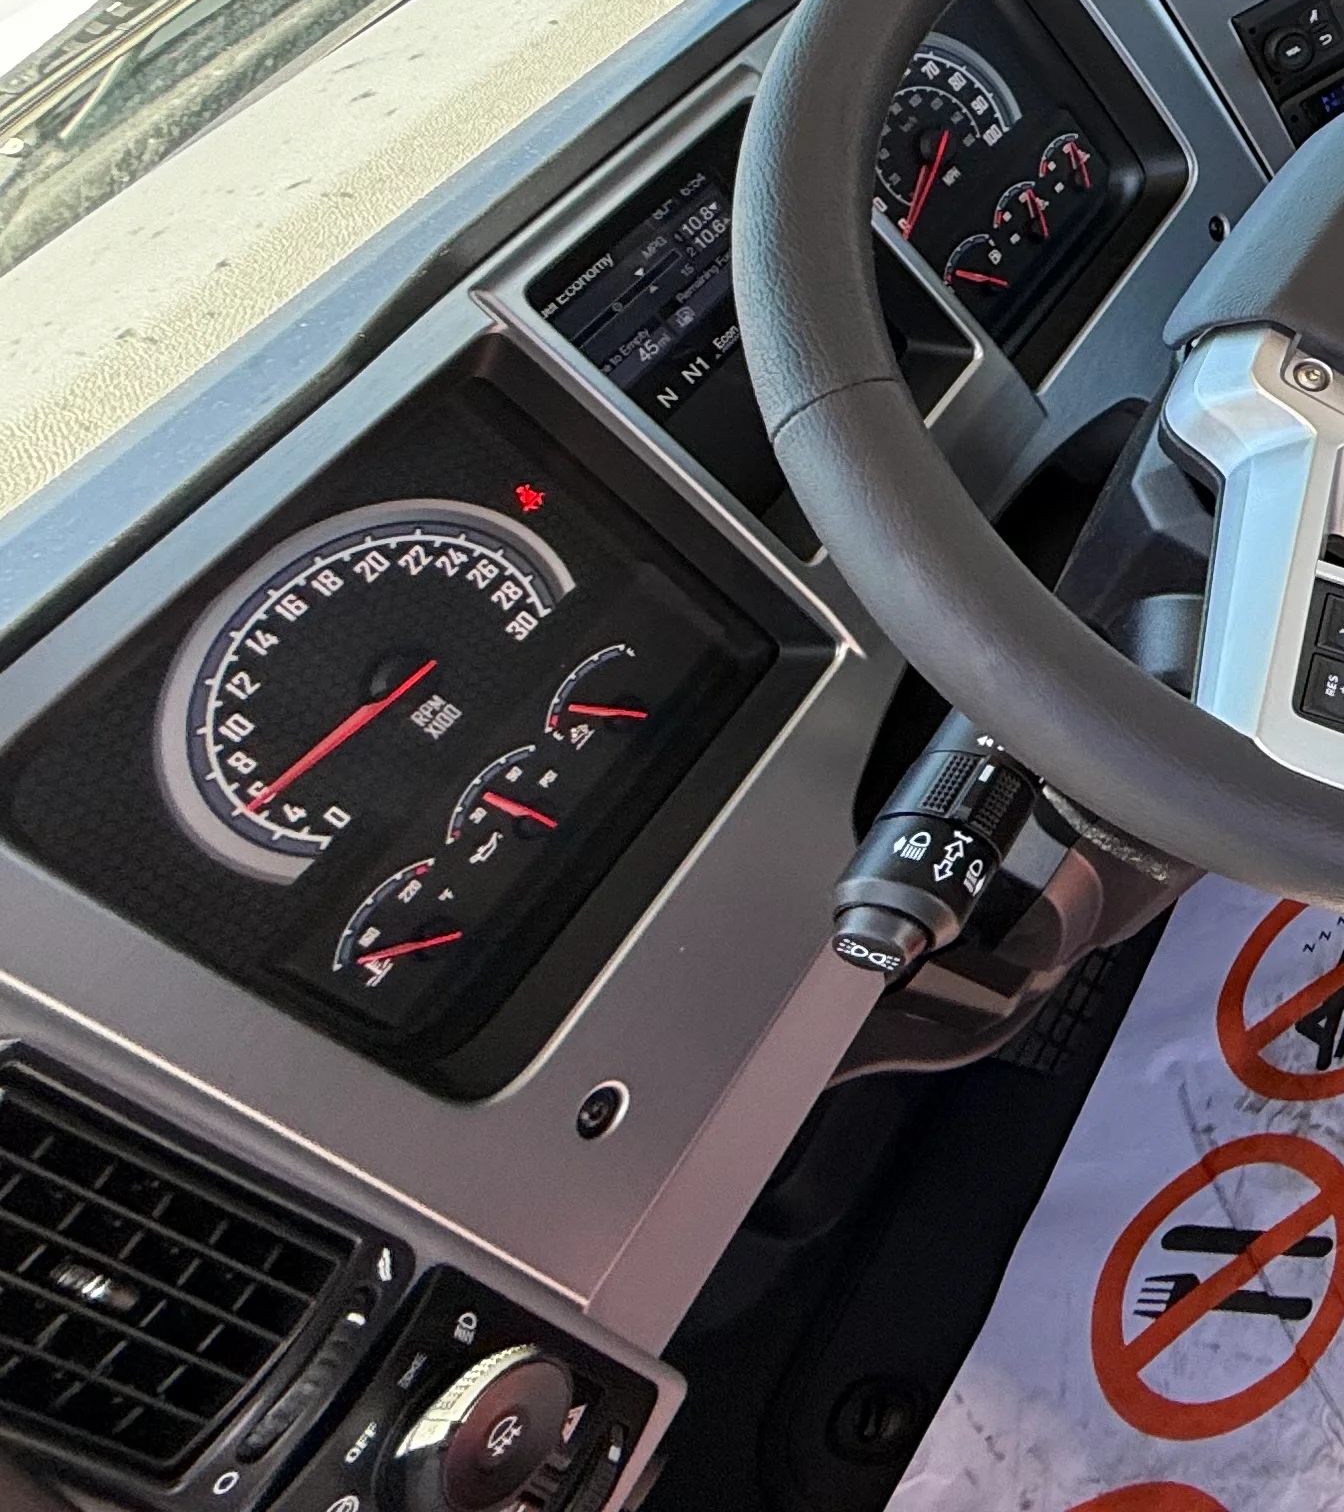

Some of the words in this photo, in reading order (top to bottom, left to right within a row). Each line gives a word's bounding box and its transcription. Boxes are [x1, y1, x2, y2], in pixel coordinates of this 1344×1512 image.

[920, 60, 941, 81] 70
[948, 71, 968, 92] 80
[970, 95, 990, 116] 90
[982, 123, 1004, 147] 100
[682, 206, 714, 236] 10.8
[694, 219, 726, 249] 10.6
[555, 253, 614, 305] Economy
[638, 339, 660, 362] 45
[657, 386, 679, 409] N
[681, 356, 711, 385] N1
[353, 550, 391, 583] 20
[397, 544, 433, 576] 22
[434, 547, 469, 577] 24
[466, 558, 500, 589] 26
[311, 569, 345, 596] 18
[490, 580, 524, 611] 28
[274, 593, 309, 622] 16
[504, 611, 539, 641] 30
[245, 630, 280, 656] 14
[225, 671, 261, 700] 12
[1324, 674, 1339, 697] RES
[411, 694, 447, 727] RPM
[423, 703, 462, 740] X100
[218, 713, 255, 743] 10
[227, 751, 257, 774] 8
[283, 803, 307, 823] 4
[323, 806, 351, 829] 0
[398, 879, 422, 903] 220
[344, 1421, 377, 1464] OFF
